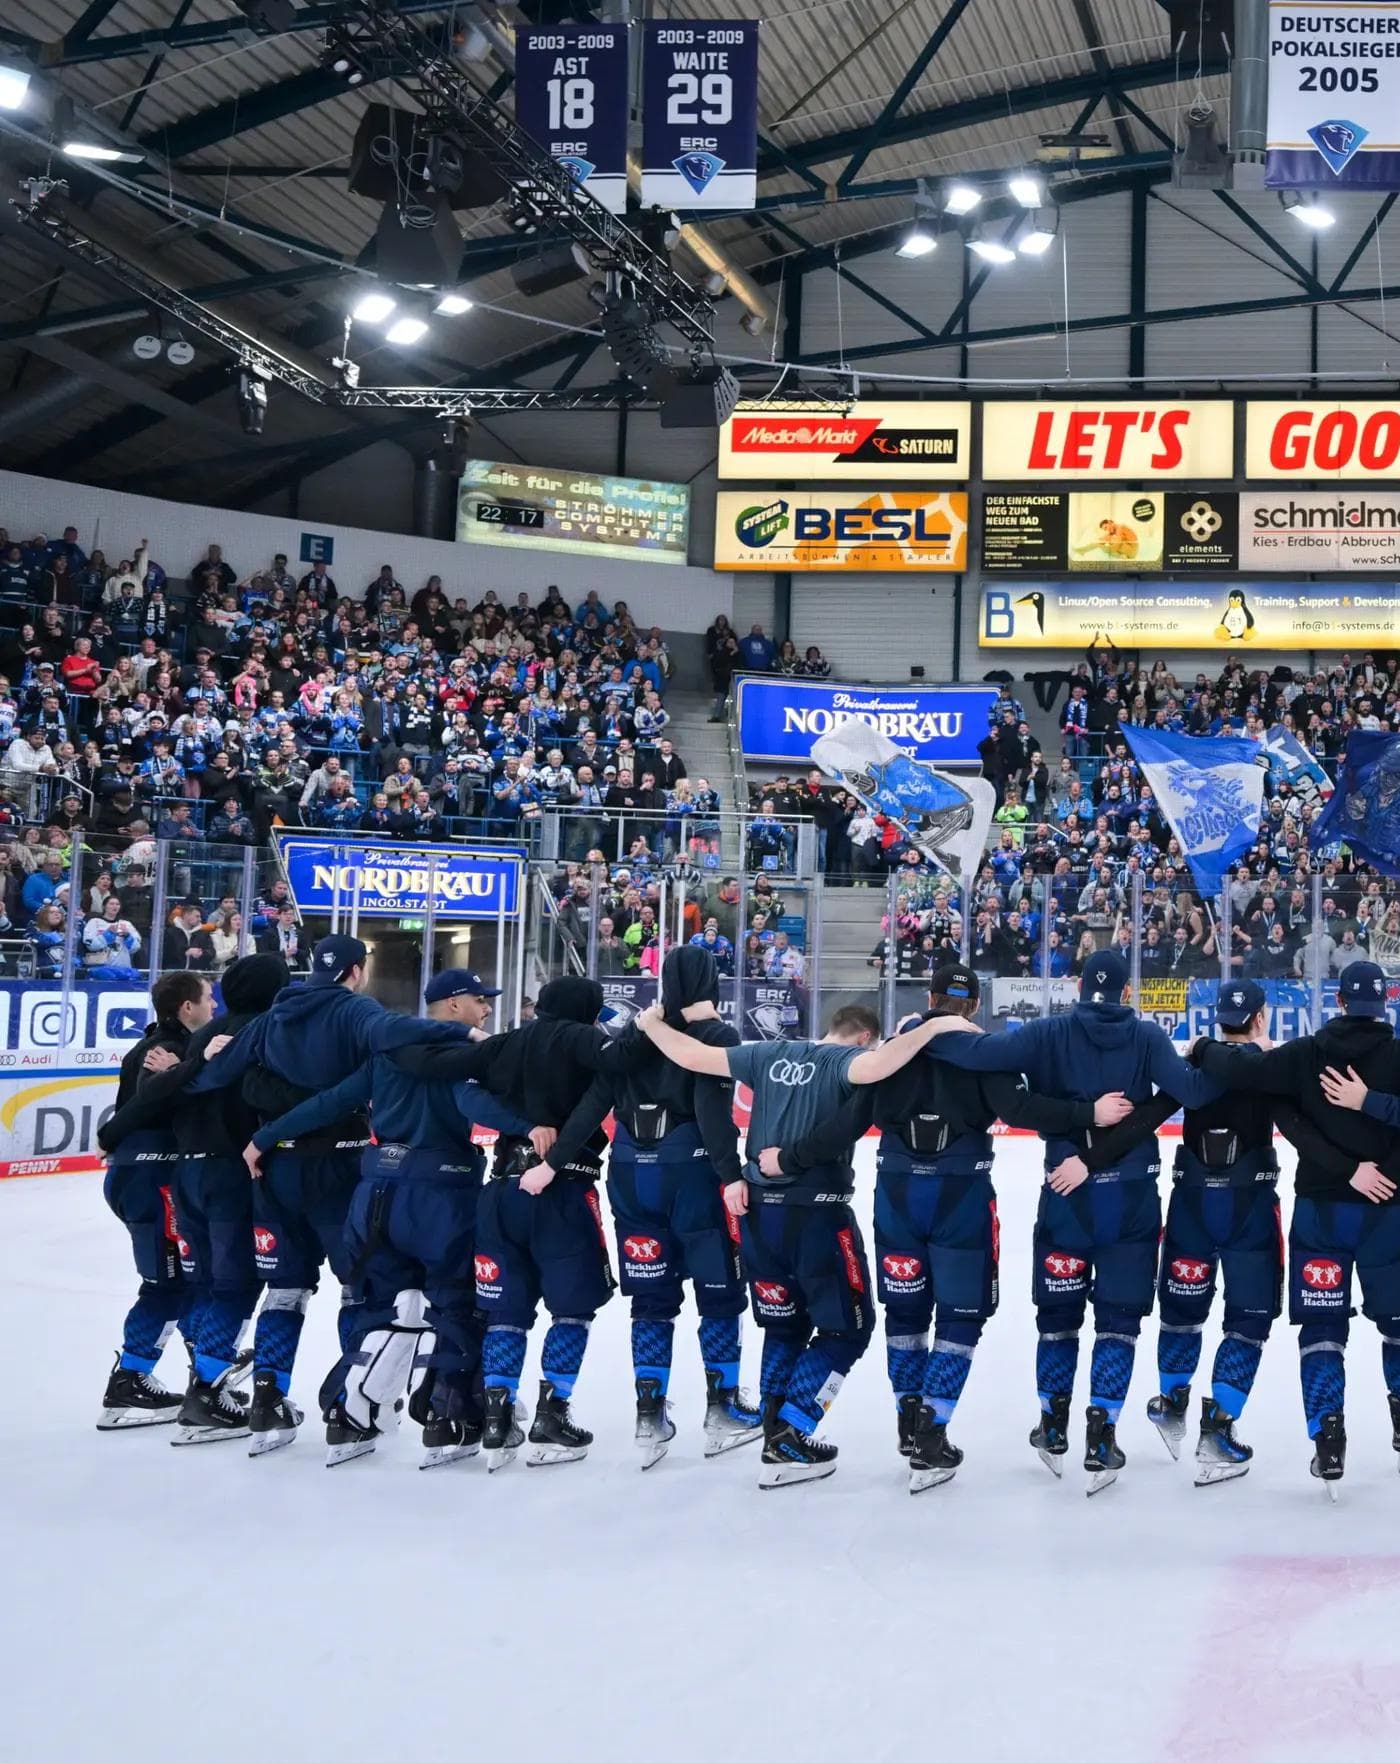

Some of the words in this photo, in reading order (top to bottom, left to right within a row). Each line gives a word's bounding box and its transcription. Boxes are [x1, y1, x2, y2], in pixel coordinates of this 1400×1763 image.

[1280, 16, 1400, 35] DEUTSCHER
[553, 57, 589, 75] AST
[673, 52, 728, 70] WAITE
[1299, 66, 1379, 93] 2005
[547, 79, 595, 130] 18
[667, 73, 733, 125] 29
[551, 142, 588, 153] ERC
[680, 137, 718, 148] ERC
[1027, 410, 1190, 470] LET'S
[900, 439, 954, 455] SATURN
[526, 475, 563, 491] für
[569, 481, 604, 496] die
[986, 496, 1005, 505] DER
[1006, 496, 1060, 505] EINFACHSTE
[555, 499, 684, 522] STRÖHMER
[985, 506, 1007, 515] WEG
[1008, 506, 1029, 515] ZUM
[554, 511, 683, 533] COMPUTER
[742, 504, 782, 531] SYSTEM
[985, 516, 1018, 526] NEUEN
[1020, 516, 1040, 526] BAD
[760, 518, 783, 538] LIFT
[795, 508, 951, 541] BESL
[561, 522, 677, 543] SYSTEME
[1253, 537, 1279, 547] Kies
[1287, 537, 1332, 547] Erdbau
[1341, 537, 1396, 547] Abbruch
[311, 538, 324, 563] E
[1180, 545, 1223, 553] elements
[889, 553, 952, 561] STAPLER
[1059, 596, 1117, 608] Linux/Open
[1119, 596, 1153, 608] Source
[1155, 596, 1213, 609] Consulting,
[1254, 597, 1298, 609] Training,
[1299, 597, 1340, 609] Support
[311, 864, 496, 900] NORDBRÄU
[600, 984, 636, 995] ERC
[21, 1055, 52, 1065] Audi
[335, 1140, 370, 1149] BAUE
[135, 1152, 181, 1161] BAUE
[563, 1162, 599, 1176] AUER
[625, 1262, 668, 1272] Backhaus
[628, 1269, 667, 1279] Hackner
[887, 1284, 926, 1294] Hackner
[1303, 1298, 1344, 1307] Hackner
